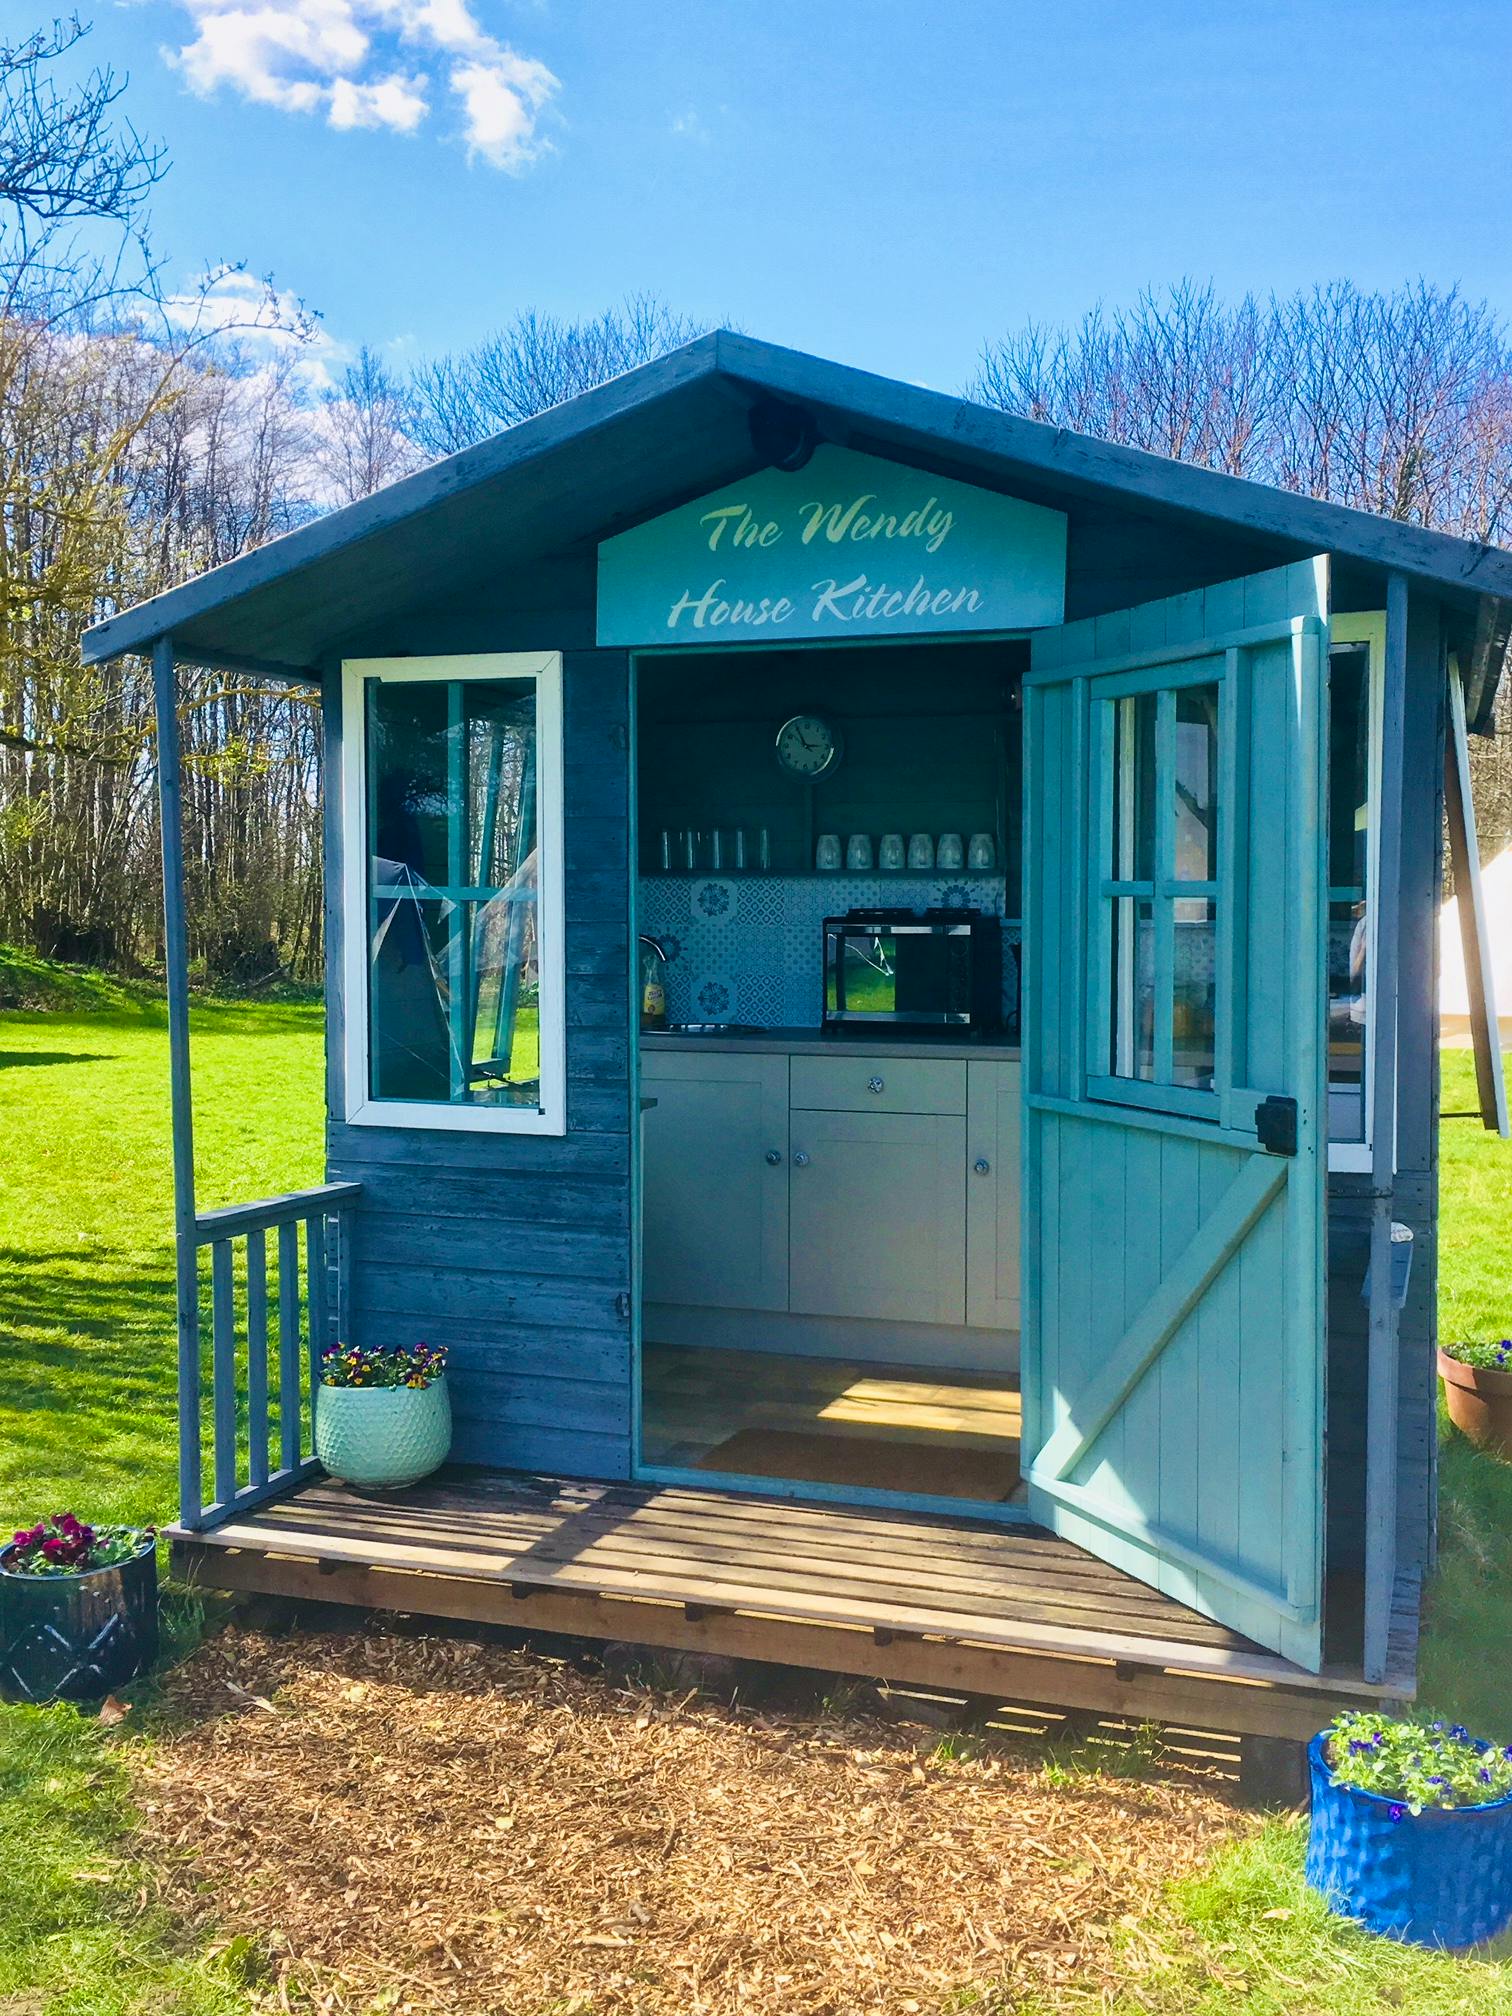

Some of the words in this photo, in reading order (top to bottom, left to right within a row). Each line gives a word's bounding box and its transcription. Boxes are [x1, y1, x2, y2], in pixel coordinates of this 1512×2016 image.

[700, 504, 782, 551] The
[799, 495, 953, 553] Wendy
[667, 579, 795, 628] House
[812, 574, 983, 621] Kitchen
